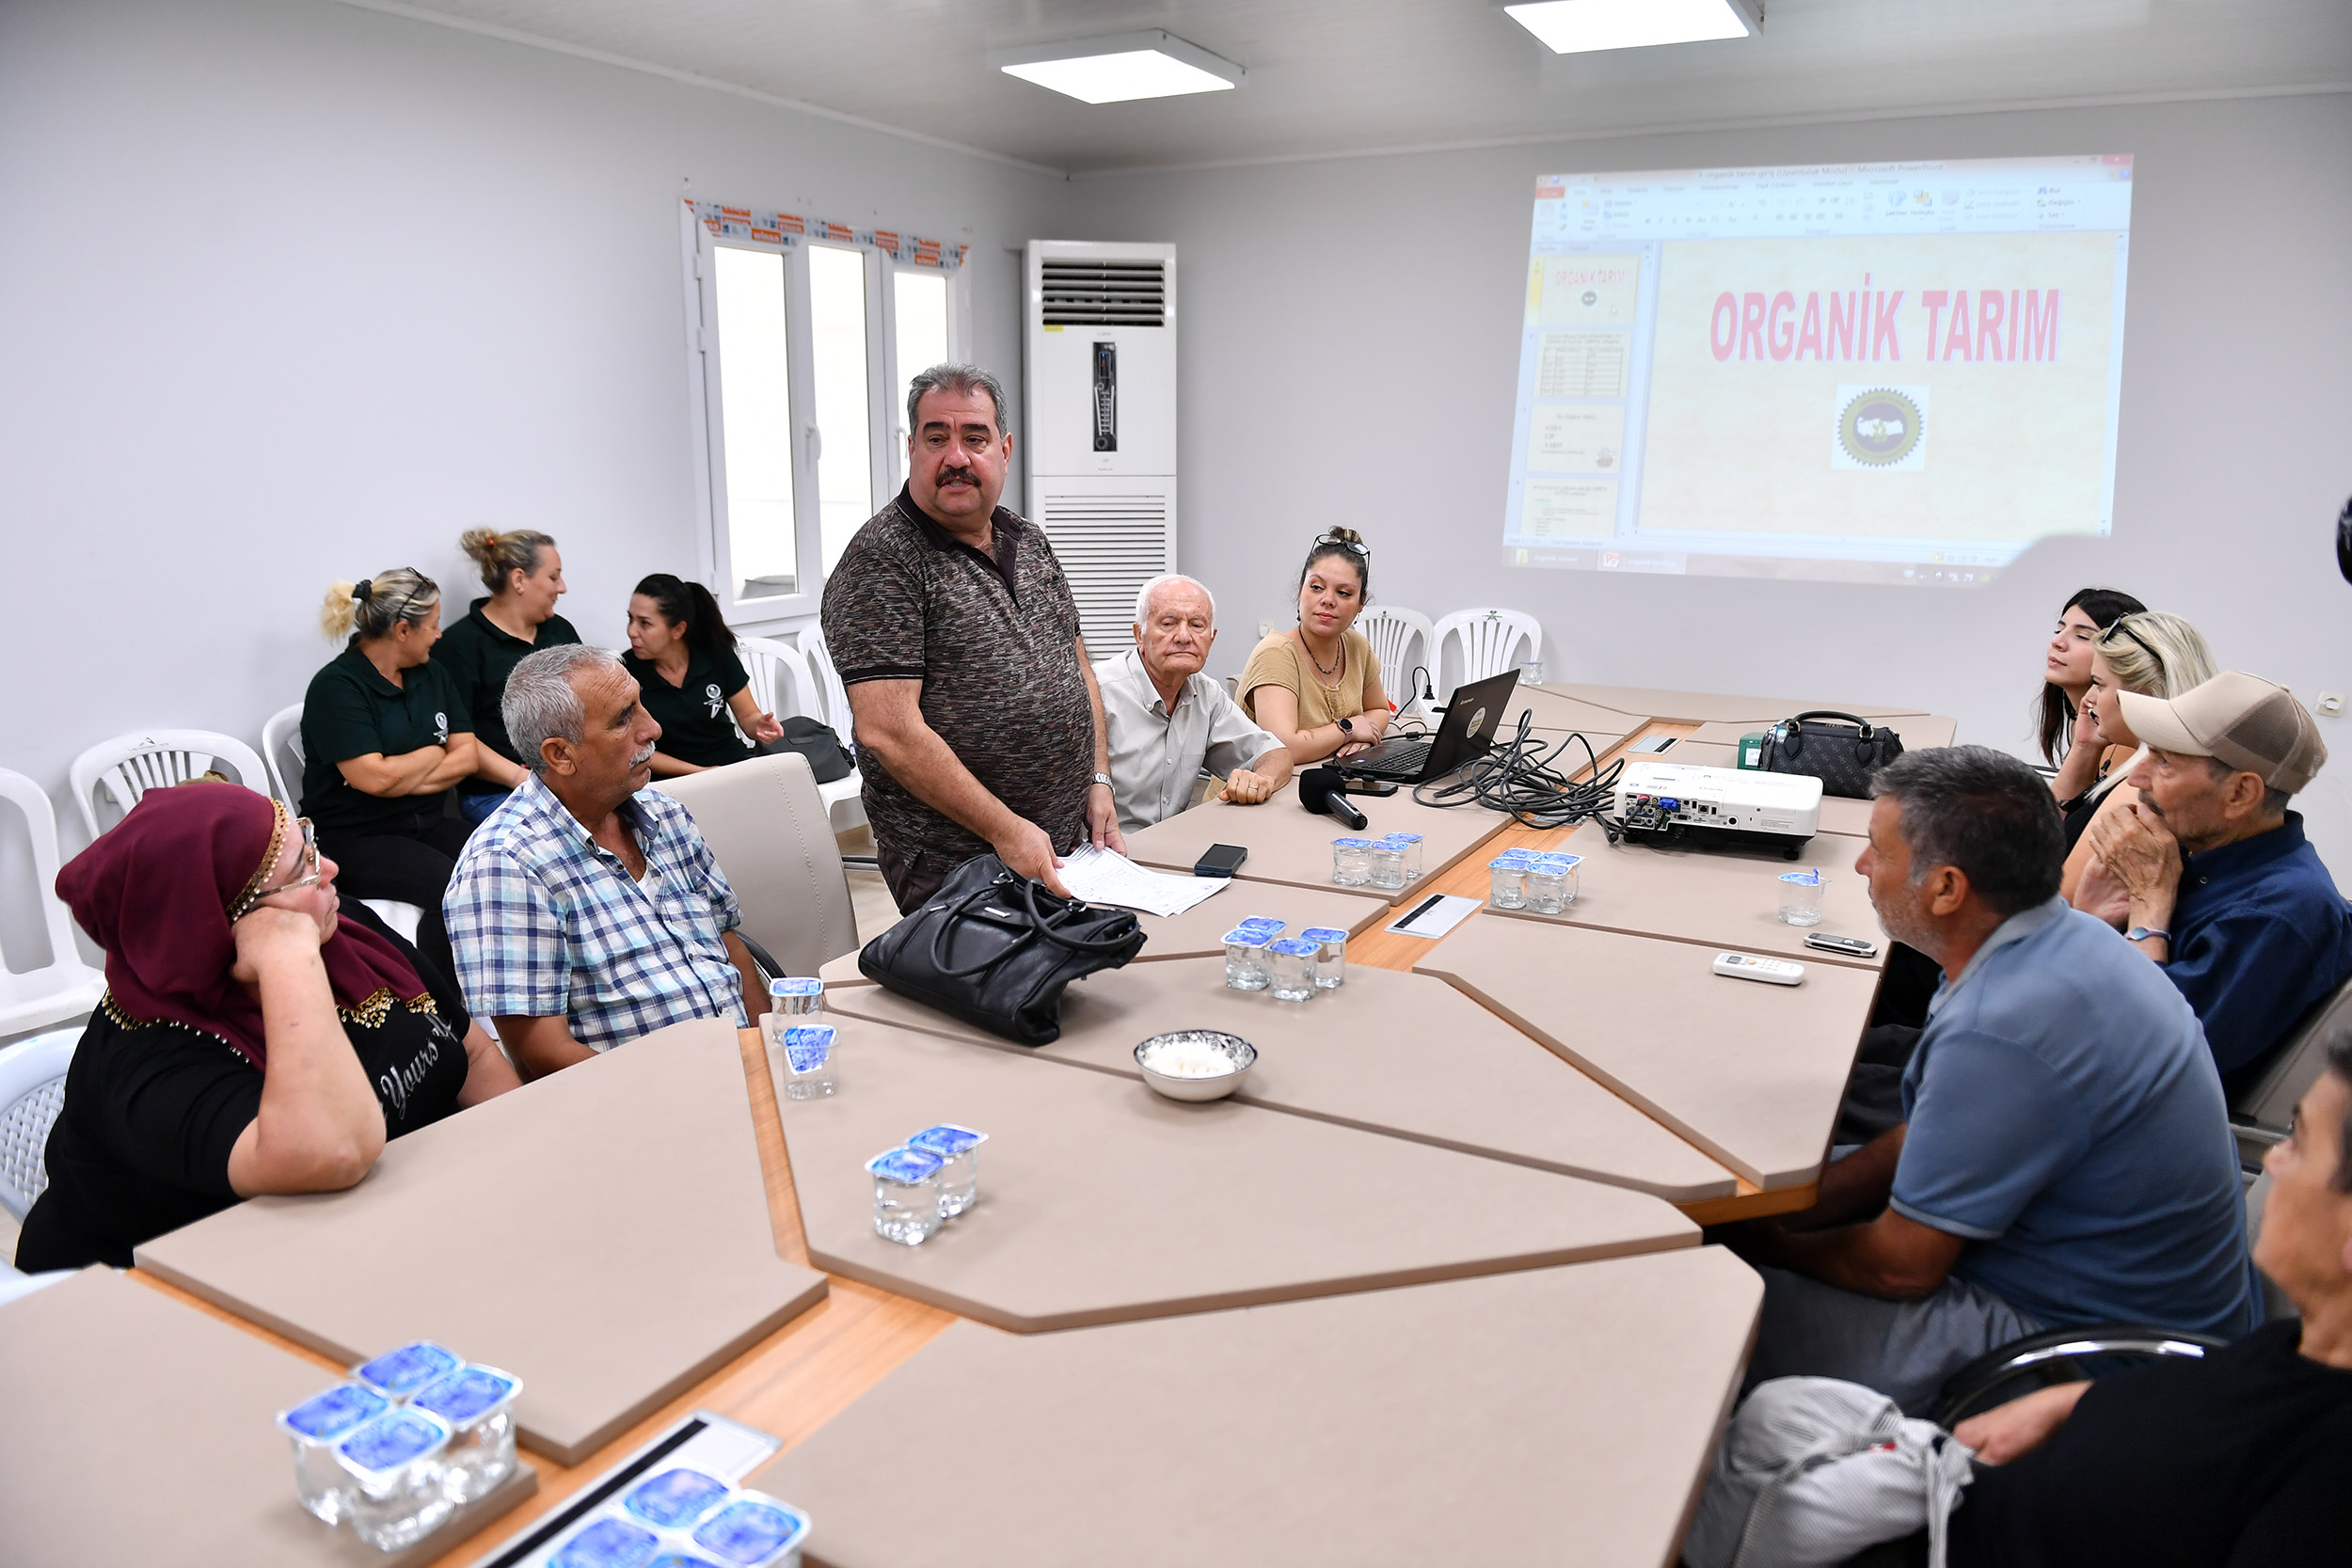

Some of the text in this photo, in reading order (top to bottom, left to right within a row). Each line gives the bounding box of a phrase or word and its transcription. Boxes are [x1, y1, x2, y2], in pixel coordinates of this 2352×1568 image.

[1858, 165, 1896, 173] Microsoft
[1898, 163, 1944, 172] PowerPoint
[1709, 272, 2062, 362] ORGANİK TARIM
[380, 1041, 439, 1120] Yours
